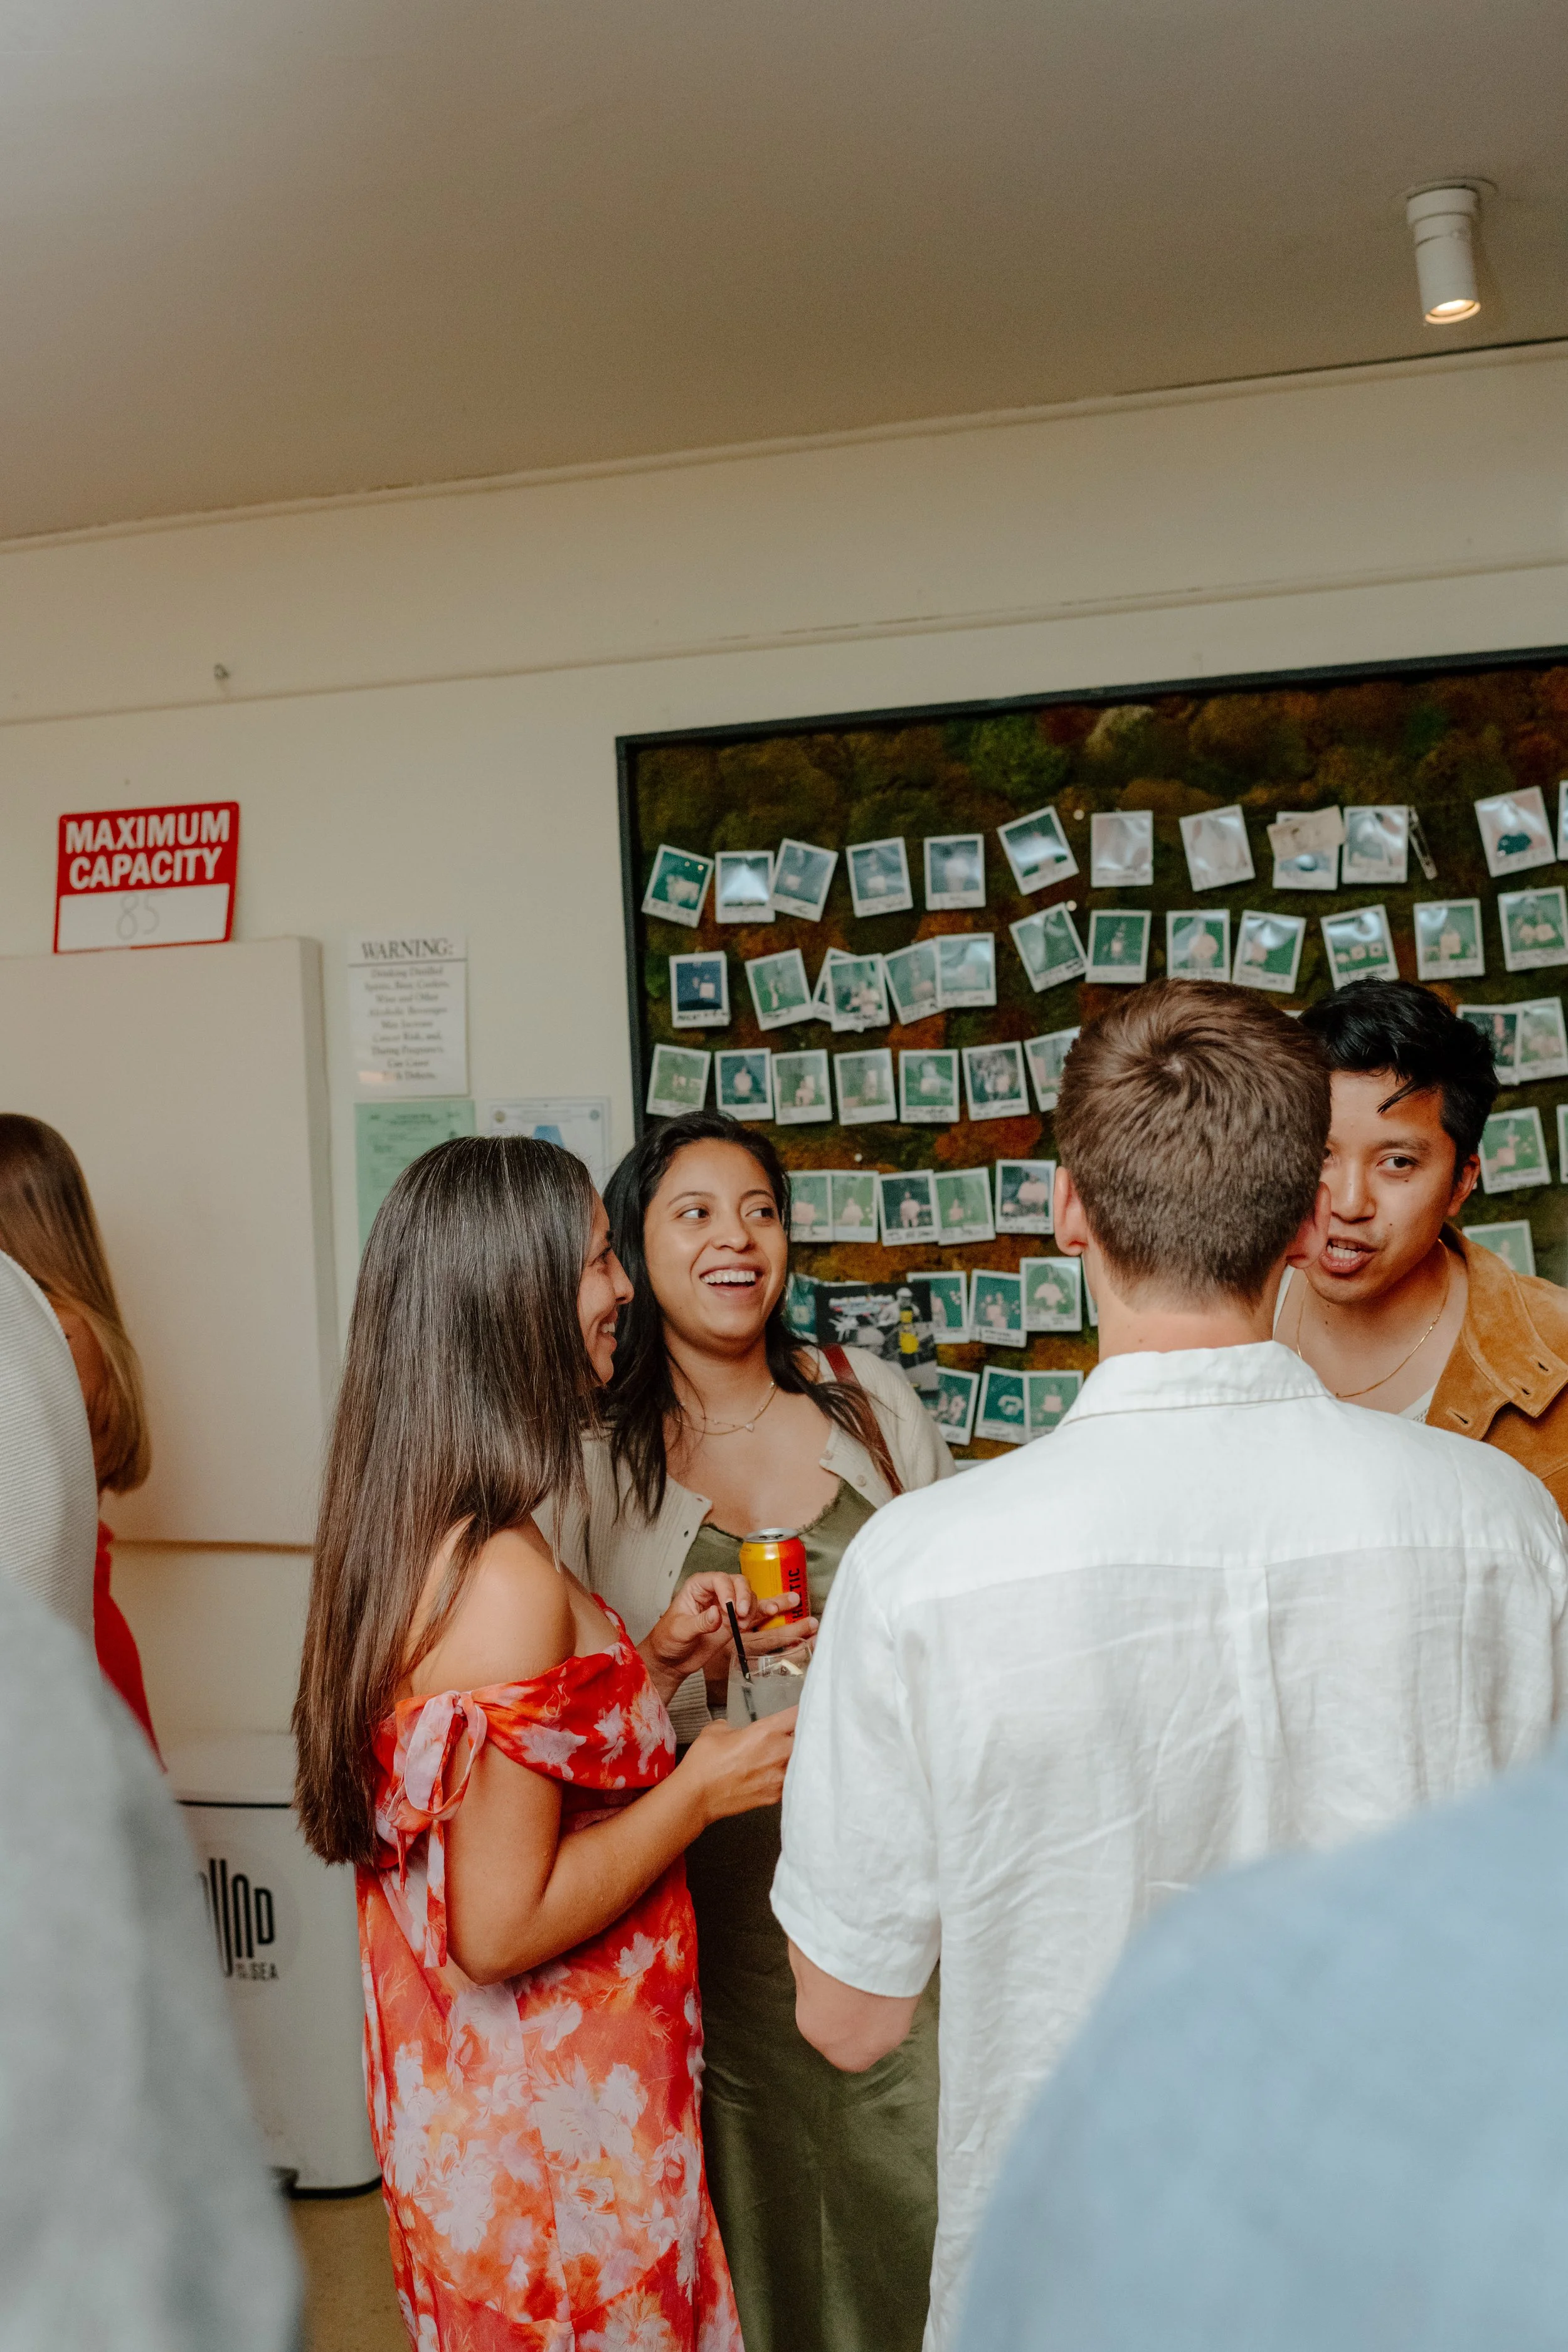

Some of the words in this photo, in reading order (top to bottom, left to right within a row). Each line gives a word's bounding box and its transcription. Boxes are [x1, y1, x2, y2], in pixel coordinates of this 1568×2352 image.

[65, 809, 230, 854] MAXIMUM
[69, 847, 223, 890] CAPACITY
[116, 891, 167, 940] 85
